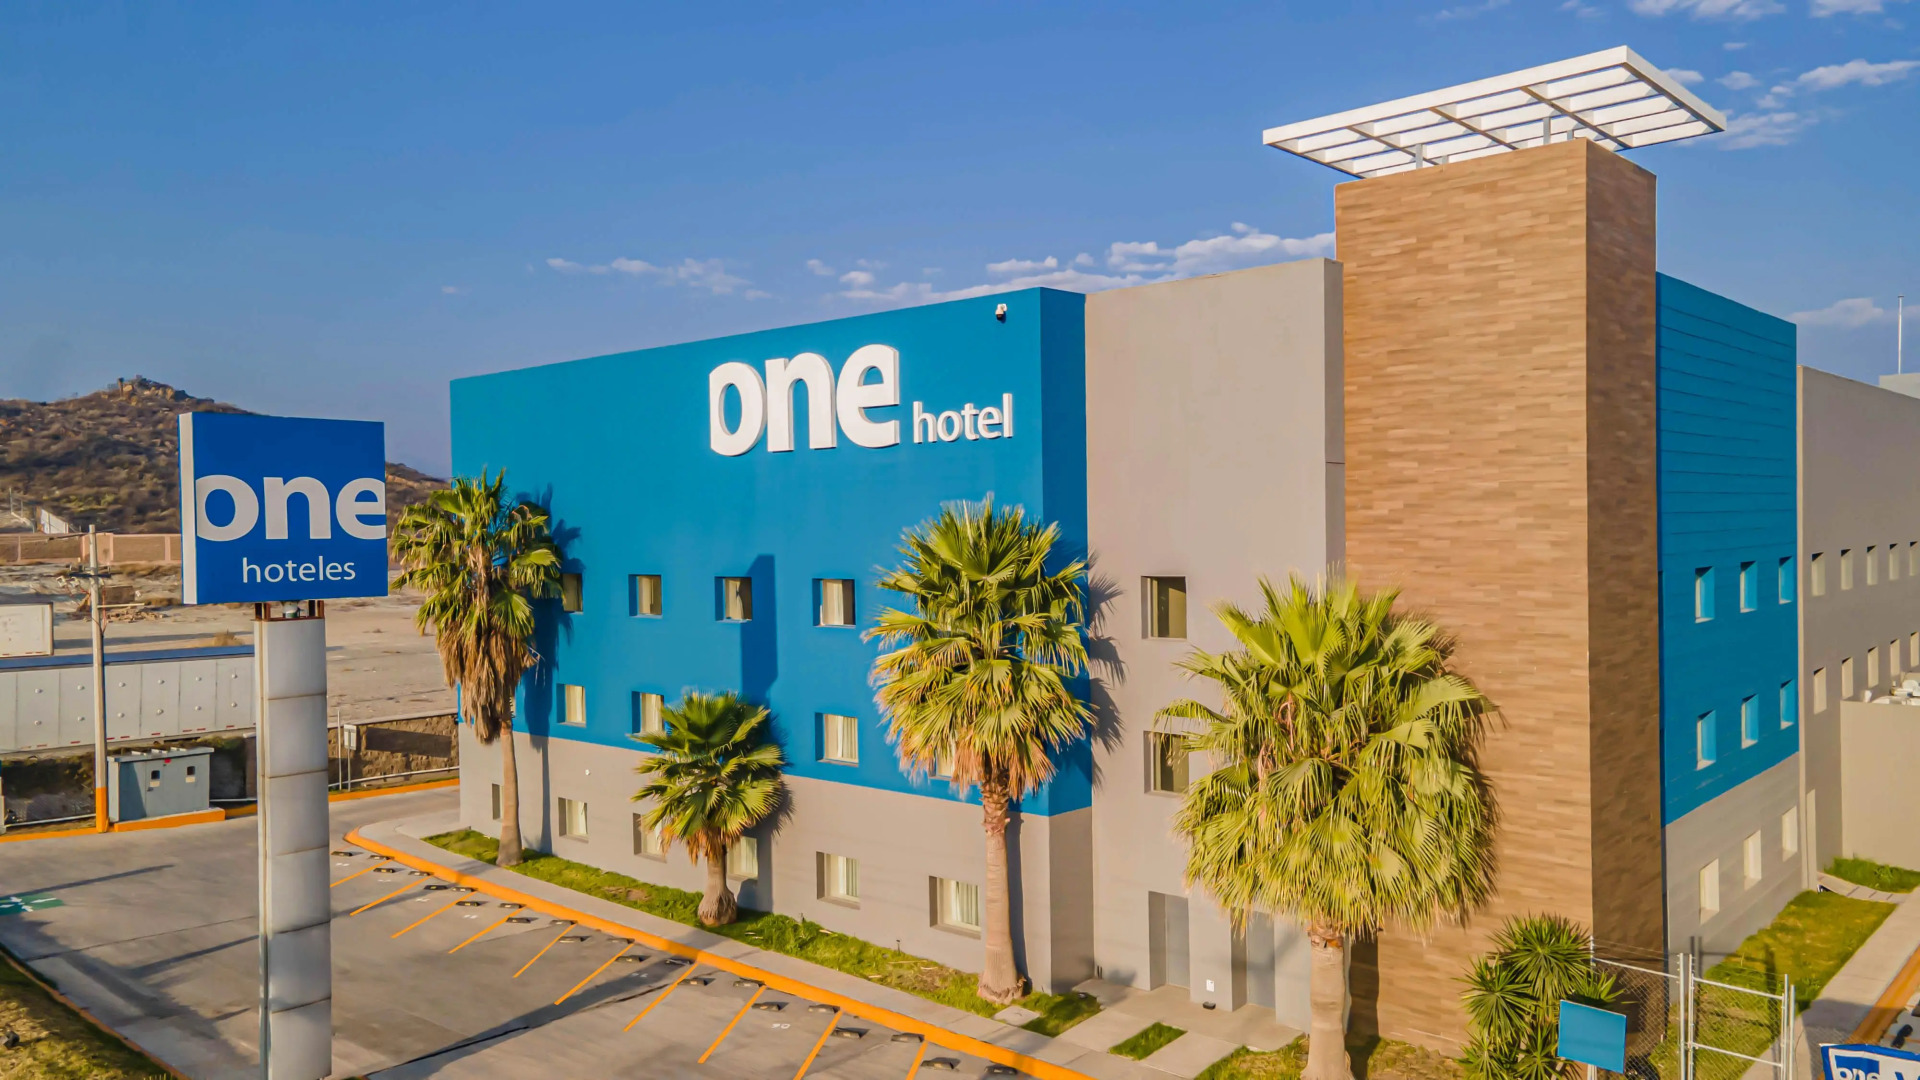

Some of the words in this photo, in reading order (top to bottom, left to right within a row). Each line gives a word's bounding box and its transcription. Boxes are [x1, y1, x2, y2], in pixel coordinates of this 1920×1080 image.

[709, 344, 899, 456] one
[913, 393, 1013, 444] hotel
[196, 474, 386, 542] one
[242, 555, 356, 583] hoteles
